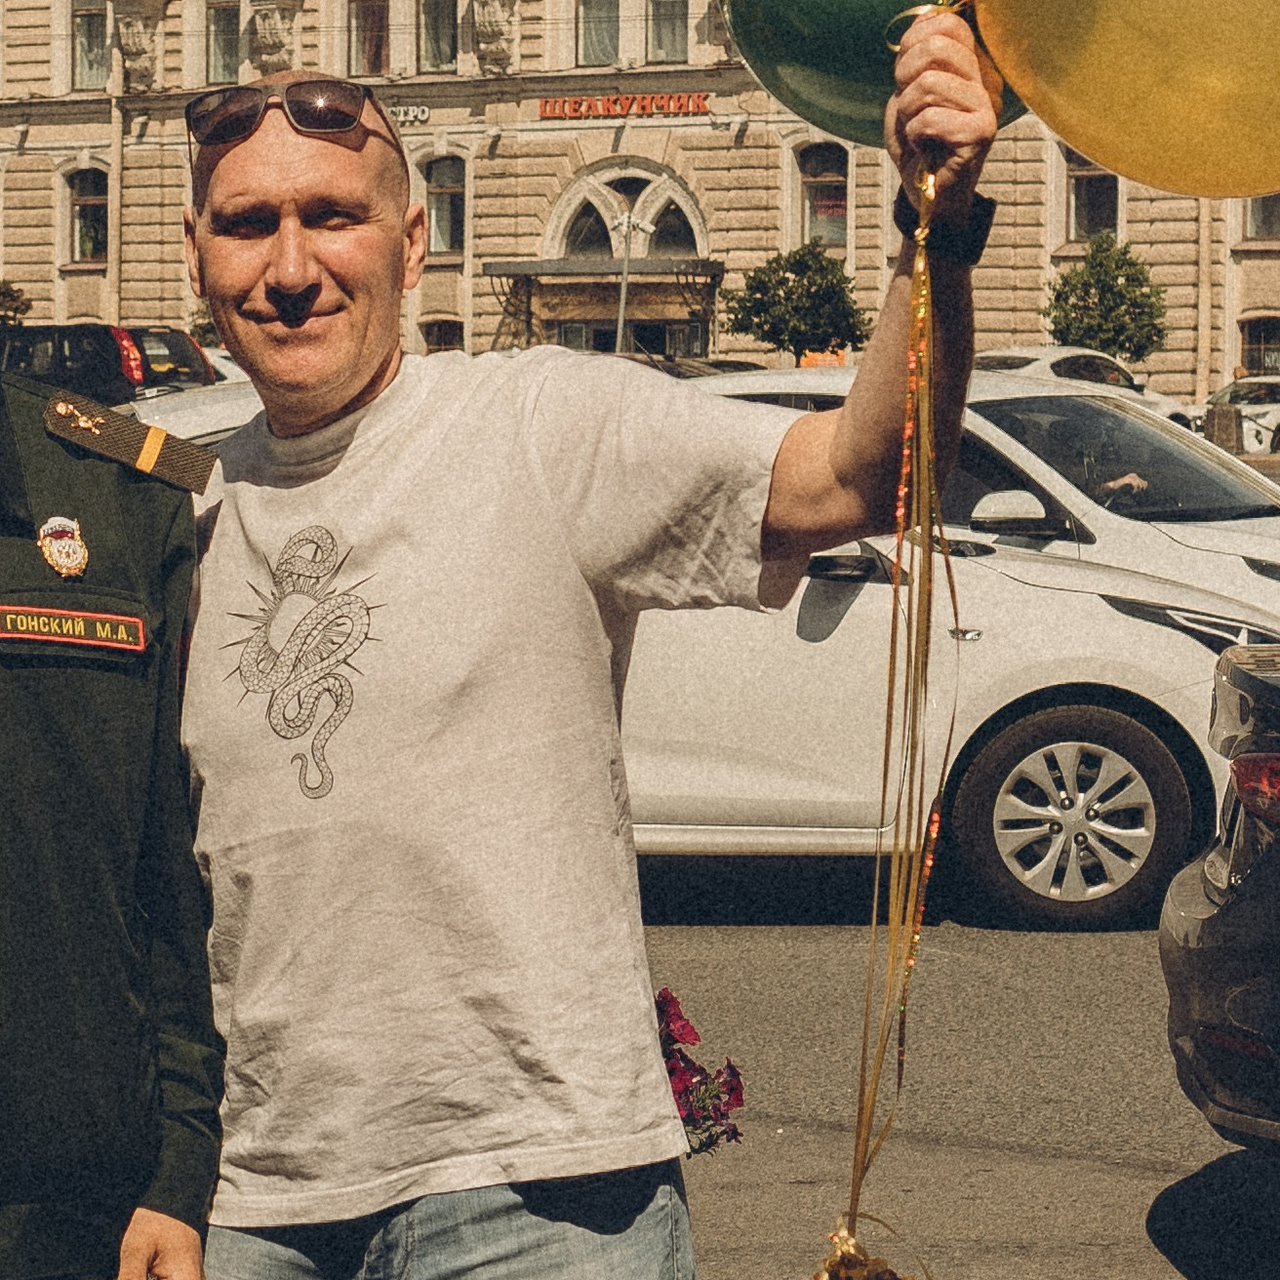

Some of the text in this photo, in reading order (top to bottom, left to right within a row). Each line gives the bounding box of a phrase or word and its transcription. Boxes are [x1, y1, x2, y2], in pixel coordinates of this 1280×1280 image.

[540, 92, 709, 119] ЩЕЛКУНЧИК
[6, 614, 135, 643] ГОНСКИЙ М.А.
